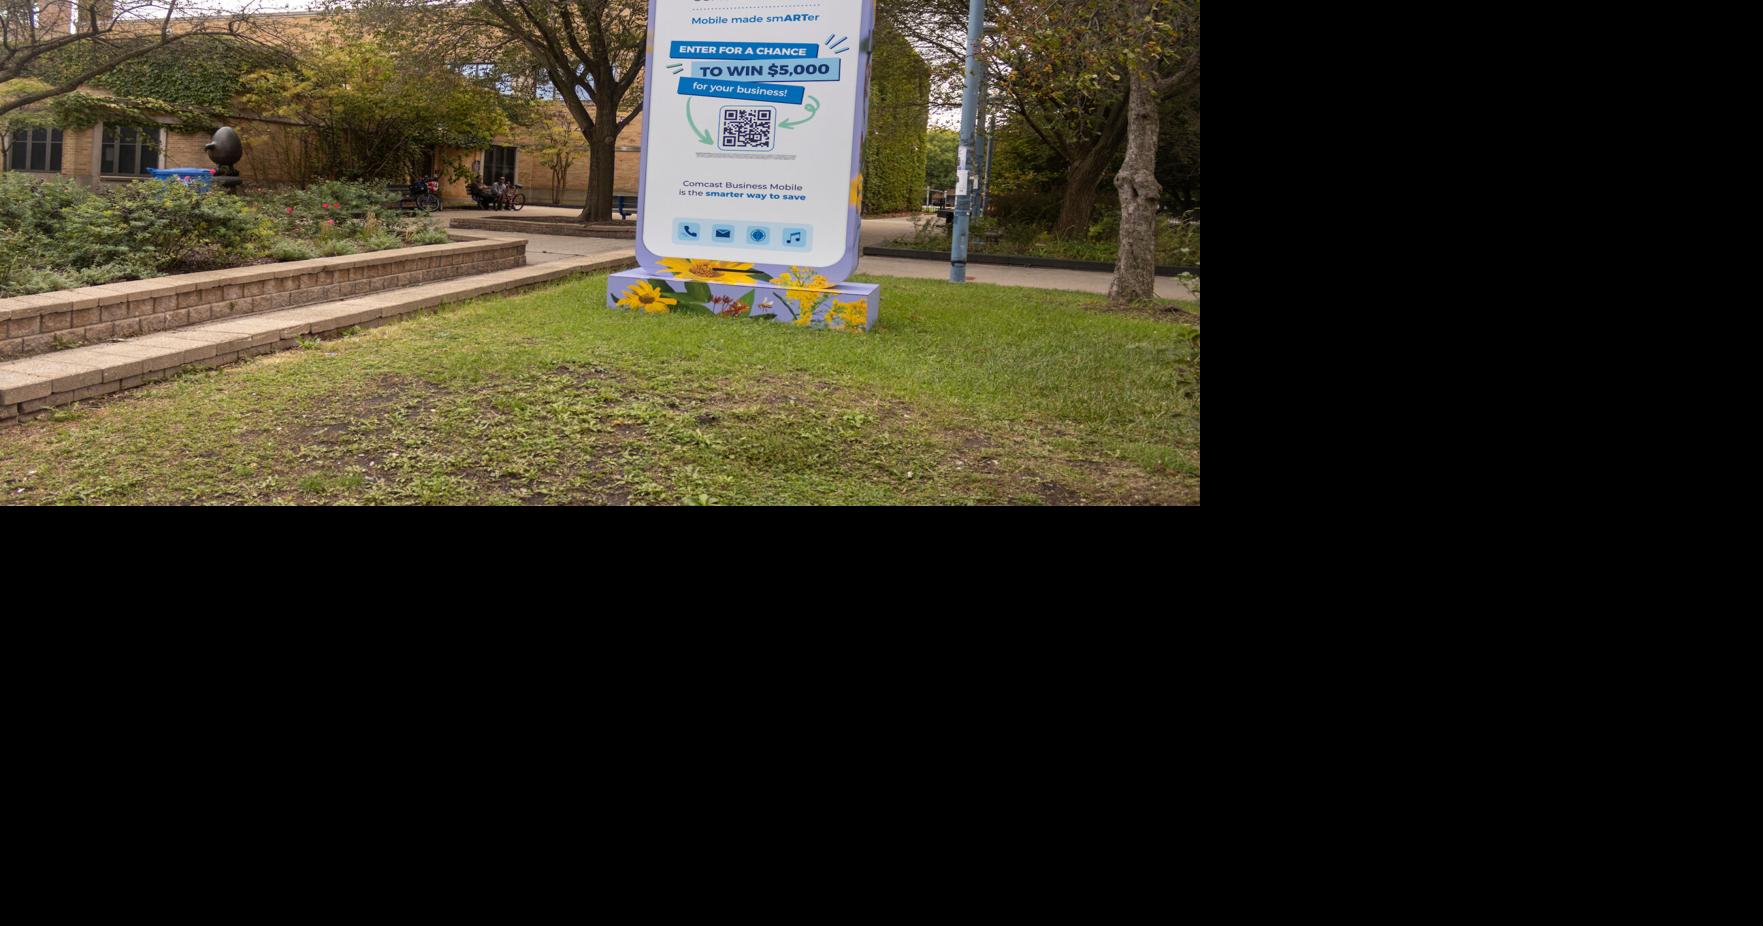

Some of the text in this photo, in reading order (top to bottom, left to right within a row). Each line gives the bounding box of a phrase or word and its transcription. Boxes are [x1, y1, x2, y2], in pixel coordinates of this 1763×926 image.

[691, 13, 820, 25] Mobile made smARTer
[679, 45, 807, 56] ENTER FOR A CHANCE
[700, 63, 830, 77] TO WIN $5,000
[692, 81, 788, 97] for your business!
[682, 180, 803, 191] Comcast Business Mobile
[688, 189, 704, 197] the
[705, 190, 744, 198] smarter
[746, 192, 767, 200] way
[769, 192, 781, 200] to
